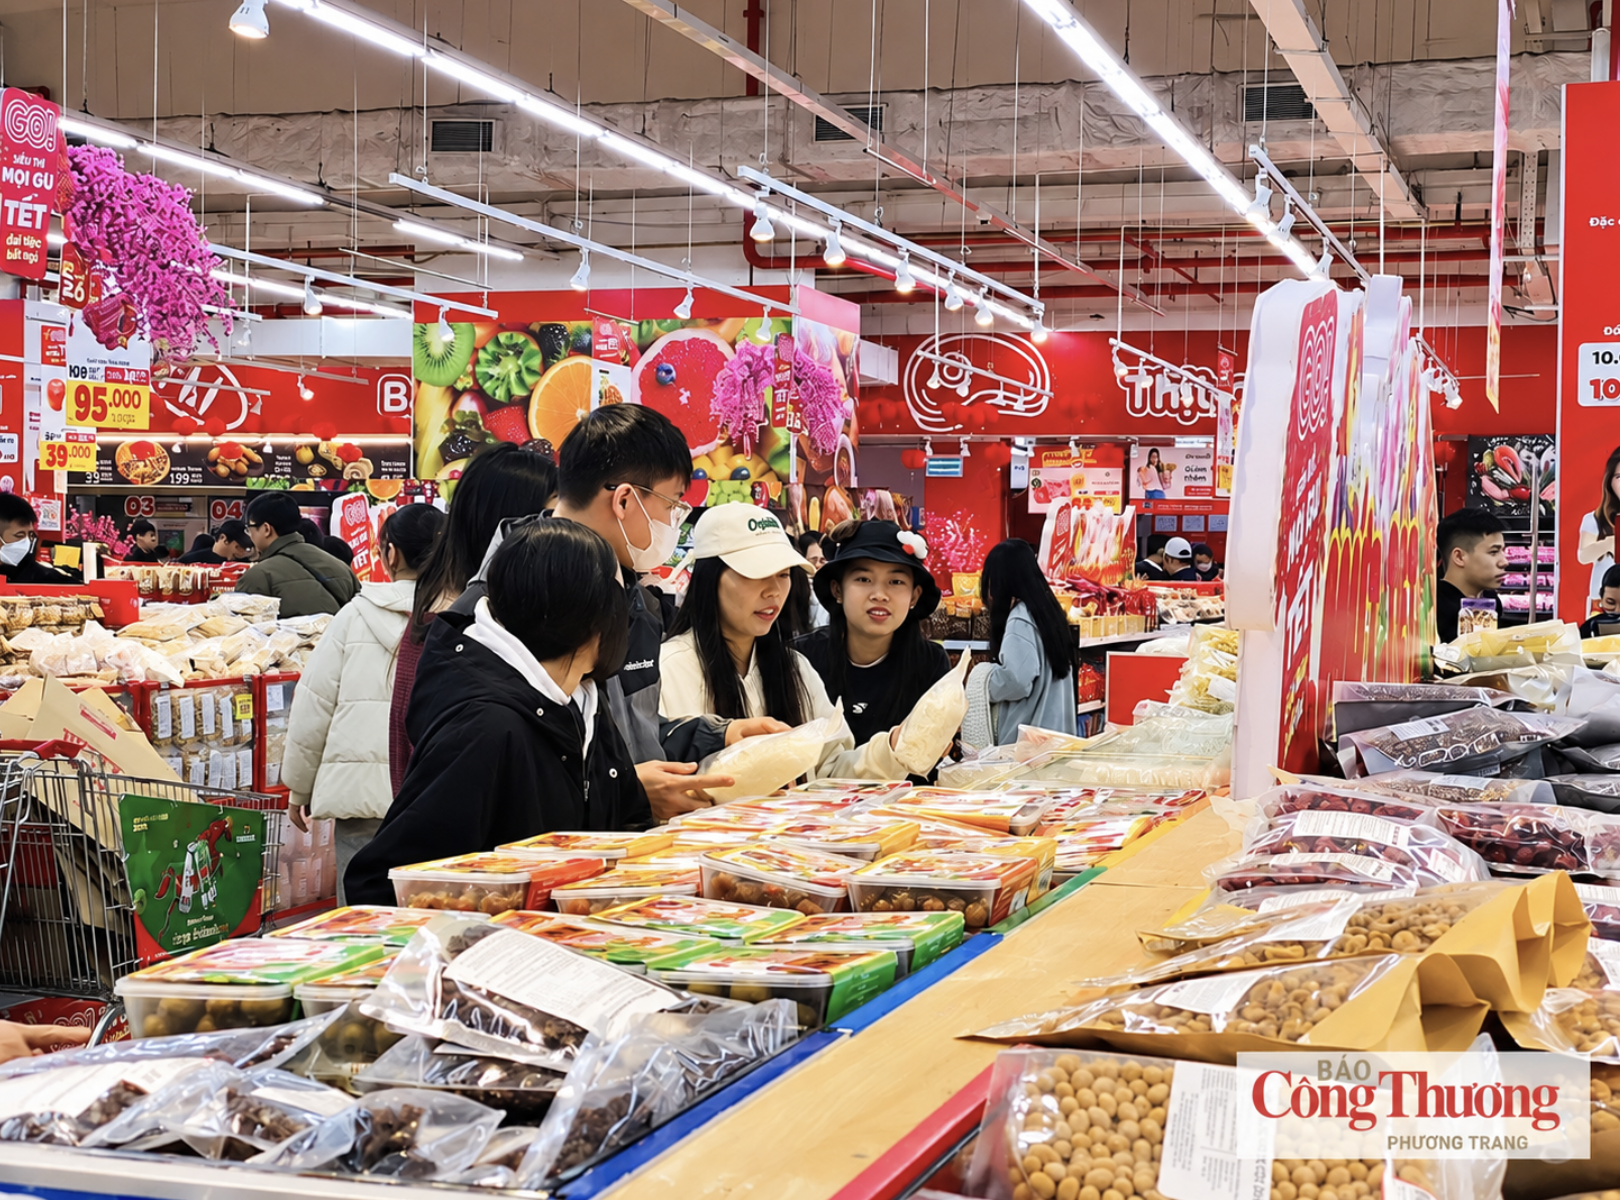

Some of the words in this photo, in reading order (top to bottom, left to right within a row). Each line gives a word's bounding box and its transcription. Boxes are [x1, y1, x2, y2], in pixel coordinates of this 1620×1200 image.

[5, 98, 56, 152] GO!
[2, 166, 30, 189] MỌI
[32, 172, 54, 190] GU
[4, 193, 48, 230] TẾT
[1589, 215, 1615, 230] Đặc
[1592, 351, 1620, 365] 10.
[75, 384, 142, 422] 95.000
[46, 444, 91, 468] 39.000
[125, 496, 154, 516] 03
[212, 500, 243, 520] 04
